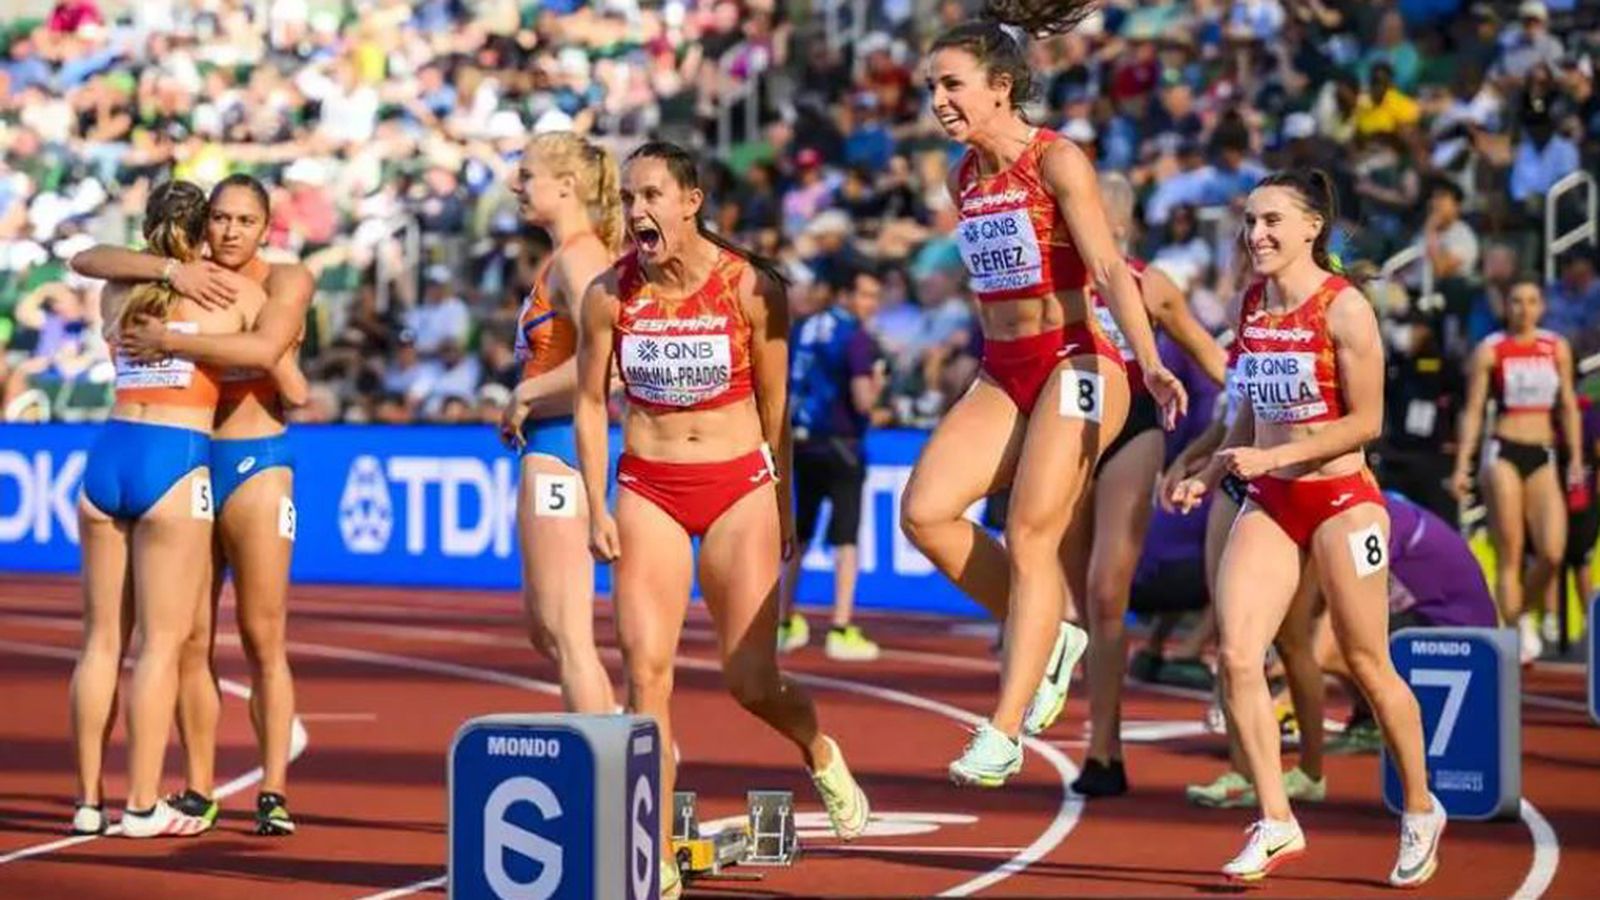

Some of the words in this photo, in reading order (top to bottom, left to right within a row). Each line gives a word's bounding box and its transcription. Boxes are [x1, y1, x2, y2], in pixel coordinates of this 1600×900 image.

[981, 217, 1019, 239] QNB
[970, 246, 1026, 272] PÉREZ
[664, 342, 714, 359] QNB
[626, 365, 728, 388] MOLINA-PRADOS
[1260, 358, 1299, 376] QNB
[1077, 378, 1095, 413] 8
[1237, 381, 1315, 404] SEVILLA
[201, 485, 210, 512] 5
[549, 483, 566, 511] 5
[1364, 534, 1382, 566] 8
[1410, 640, 1472, 657] MONDO
[1410, 668, 1472, 758] 7
[486, 736, 561, 758] MONDO
[483, 775, 564, 900] 6
[631, 774, 654, 900] 6
